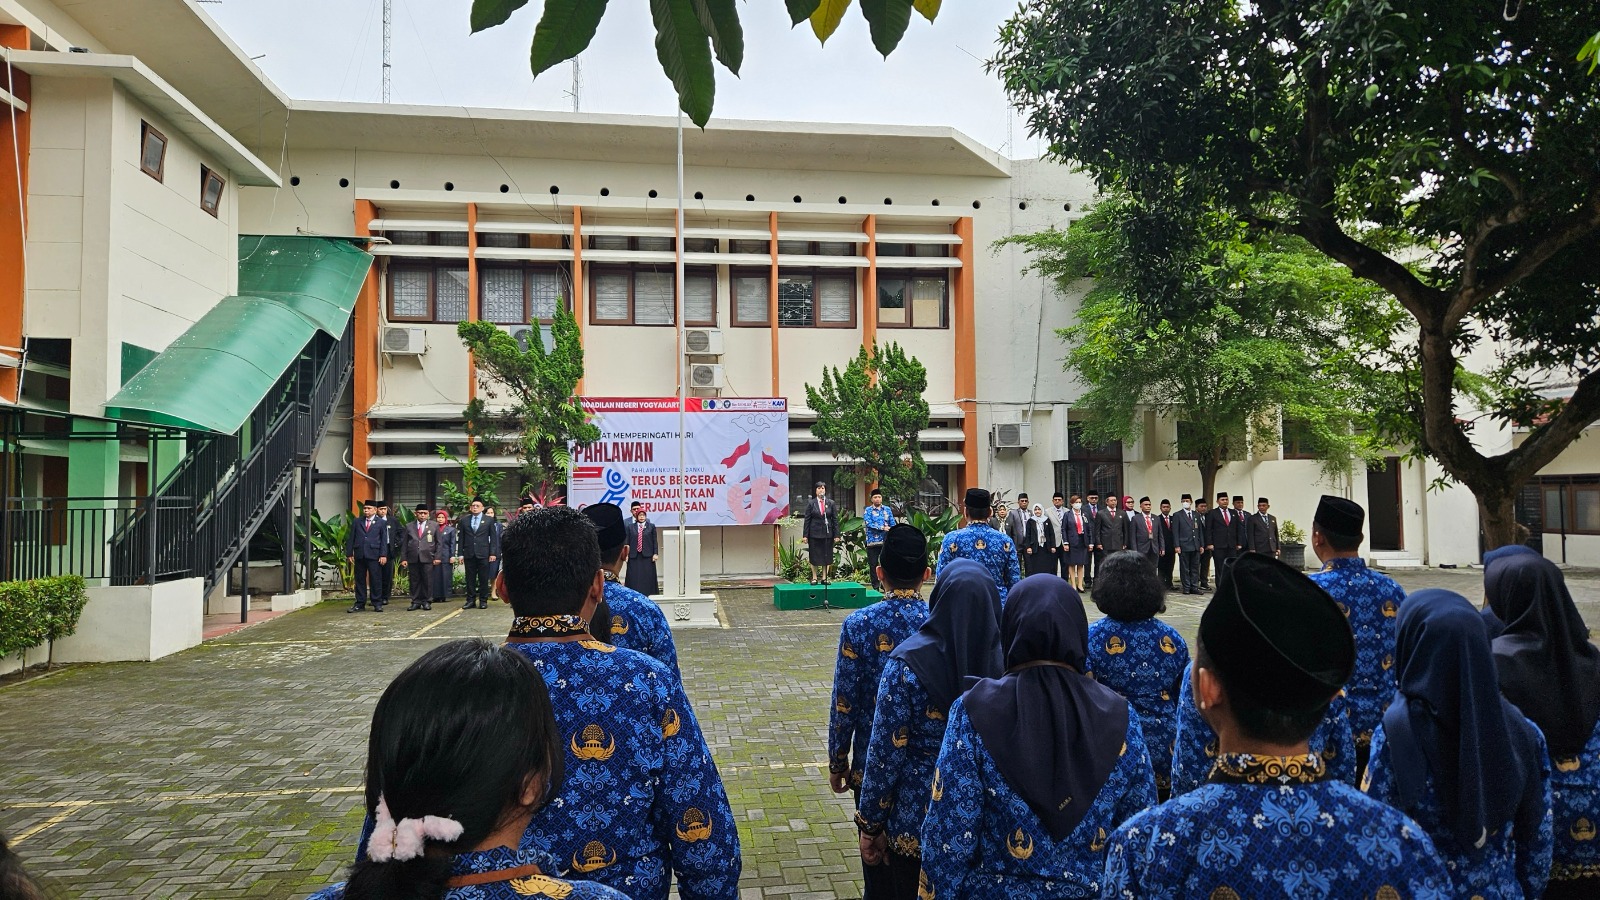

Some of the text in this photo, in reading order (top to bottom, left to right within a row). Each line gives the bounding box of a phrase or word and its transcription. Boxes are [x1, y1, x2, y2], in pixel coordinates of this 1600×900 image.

[574, 442, 653, 462] PAHLAWAN
[631, 475, 666, 485] TERUS
[640, 501, 707, 512] ERJUANGAN
